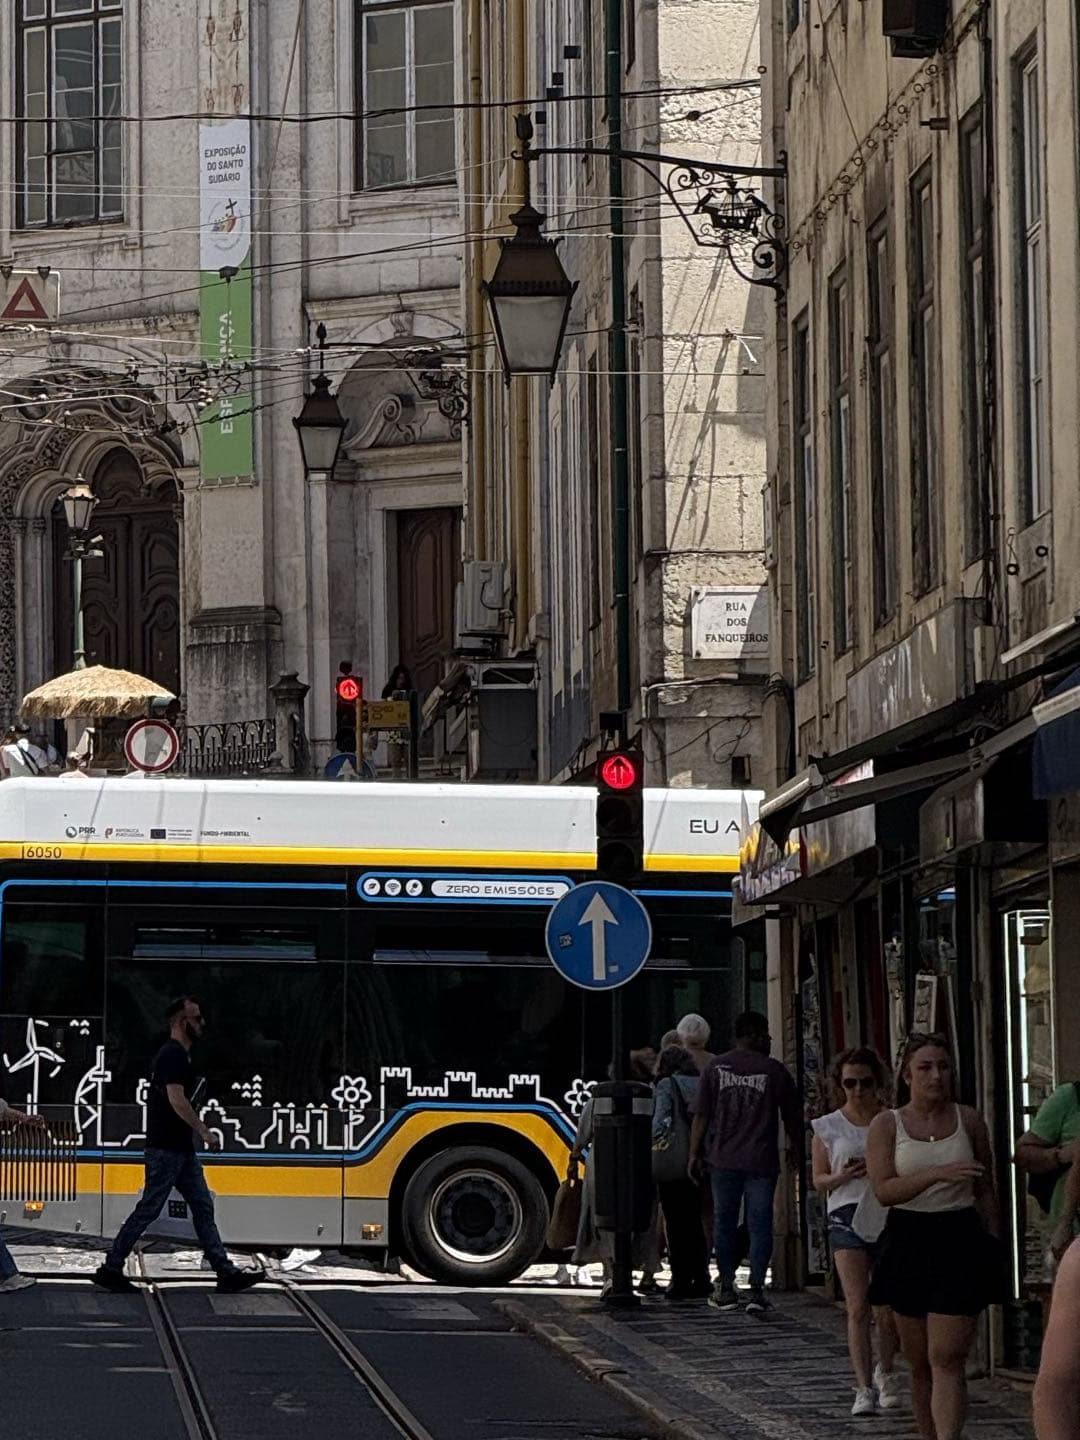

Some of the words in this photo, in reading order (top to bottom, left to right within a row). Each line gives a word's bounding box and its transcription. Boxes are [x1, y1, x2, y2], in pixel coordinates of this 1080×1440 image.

[204, 144, 246, 158] EXPOSIÇÃO
[207, 162, 217, 171] DO
[218, 159, 244, 170] SANTO
[725, 602, 747, 612] RUA
[726, 618, 747, 627] DOS
[705, 633, 769, 643] FANQUEIROS
[79, 826, 96, 834] PRR
[690, 820, 719, 834] EU
[26, 846, 62, 859] 6050
[446, 885, 480, 894] ZERO
